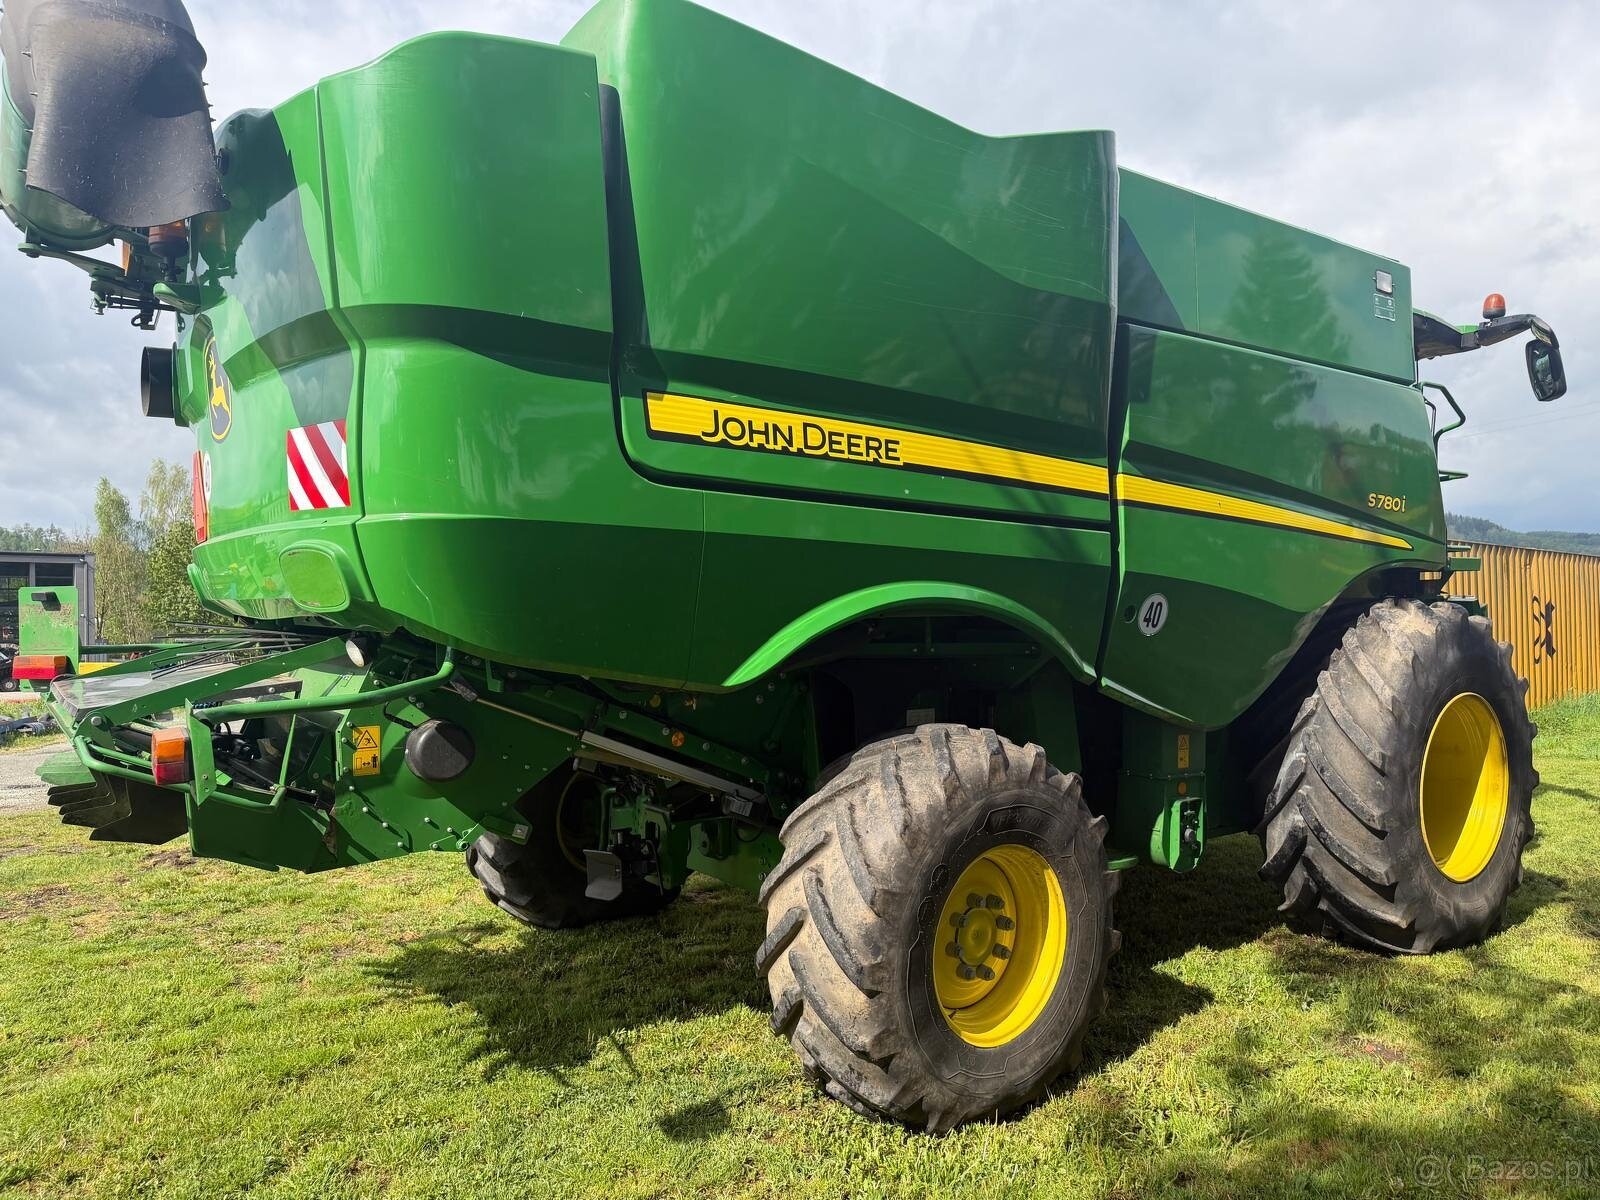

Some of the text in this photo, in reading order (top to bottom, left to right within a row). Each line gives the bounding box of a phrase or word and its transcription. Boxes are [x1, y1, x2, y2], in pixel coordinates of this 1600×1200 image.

[701, 409, 902, 463] JOHN DEERE
[1368, 493, 1406, 513] S780i
[1143, 601, 1163, 628] 40
